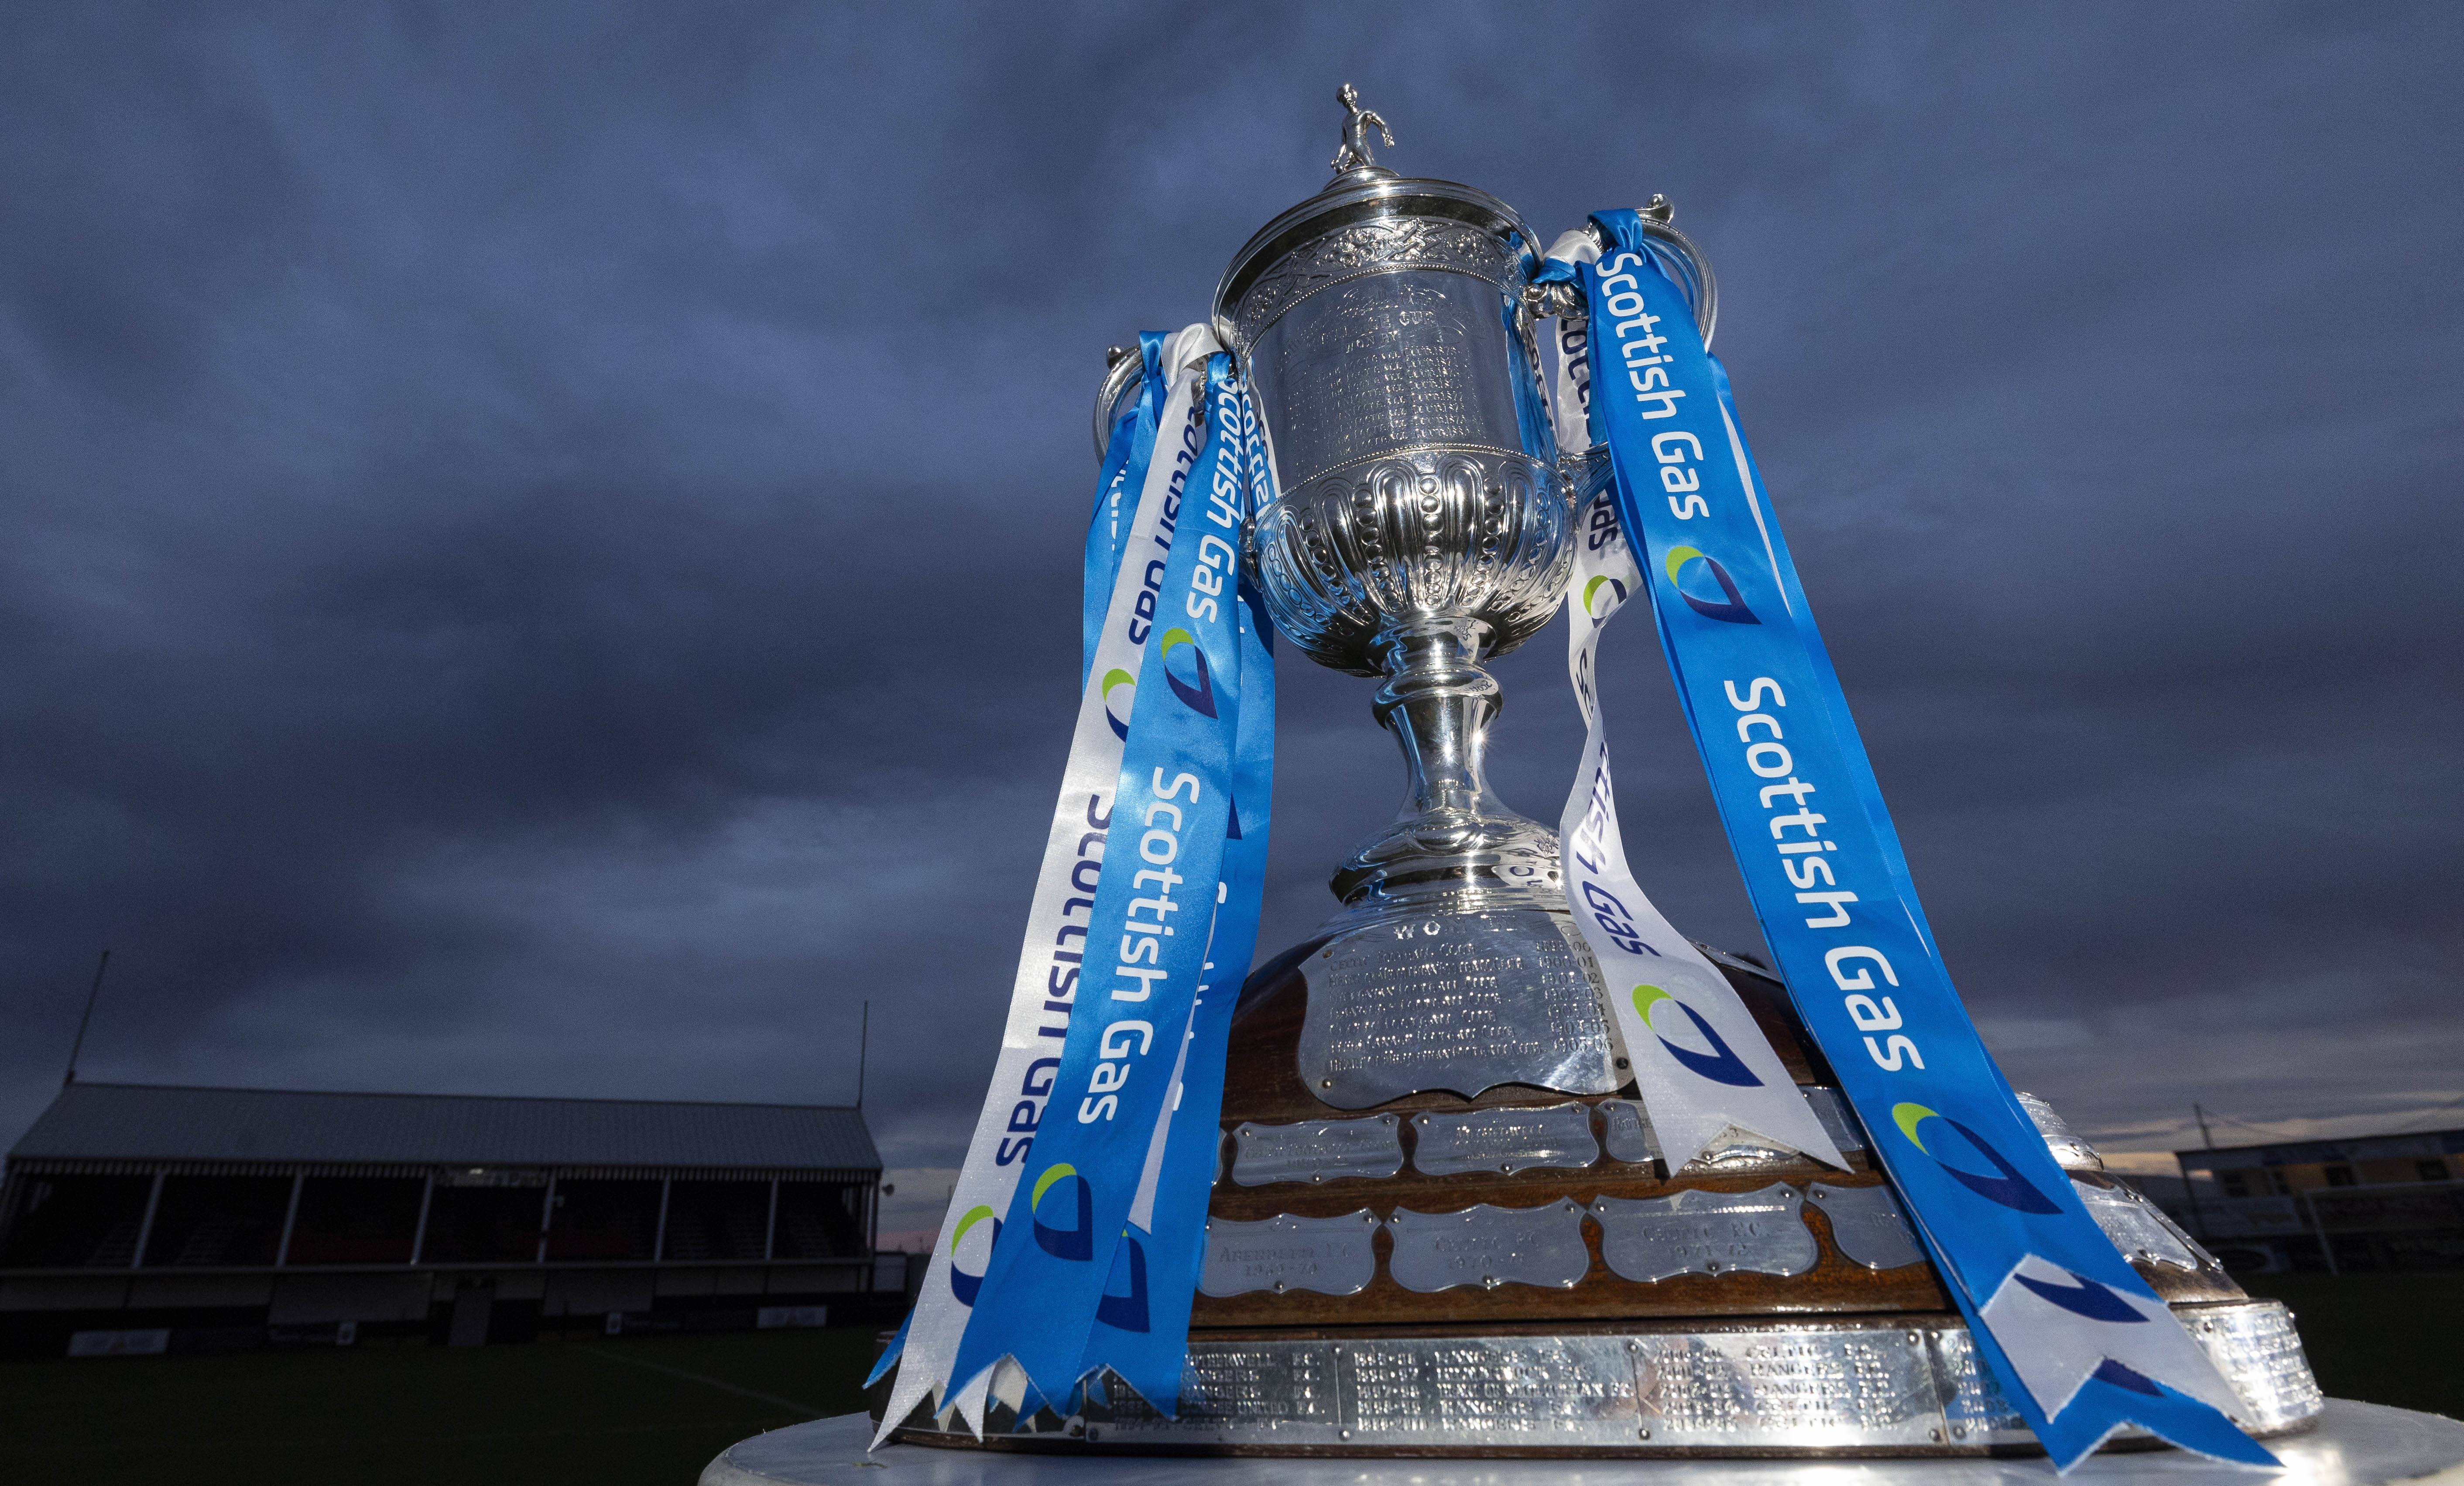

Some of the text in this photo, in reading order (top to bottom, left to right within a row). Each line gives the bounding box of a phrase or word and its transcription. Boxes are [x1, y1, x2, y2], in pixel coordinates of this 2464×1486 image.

[1595, 253, 1710, 521] Scottish Gas
[1186, 535, 1235, 623] Gas
[1078, 766, 1200, 1124] Scottish Gas
[1582, 881, 1662, 957] Gas
[1724, 677, 1926, 1071] Scottish Gas
